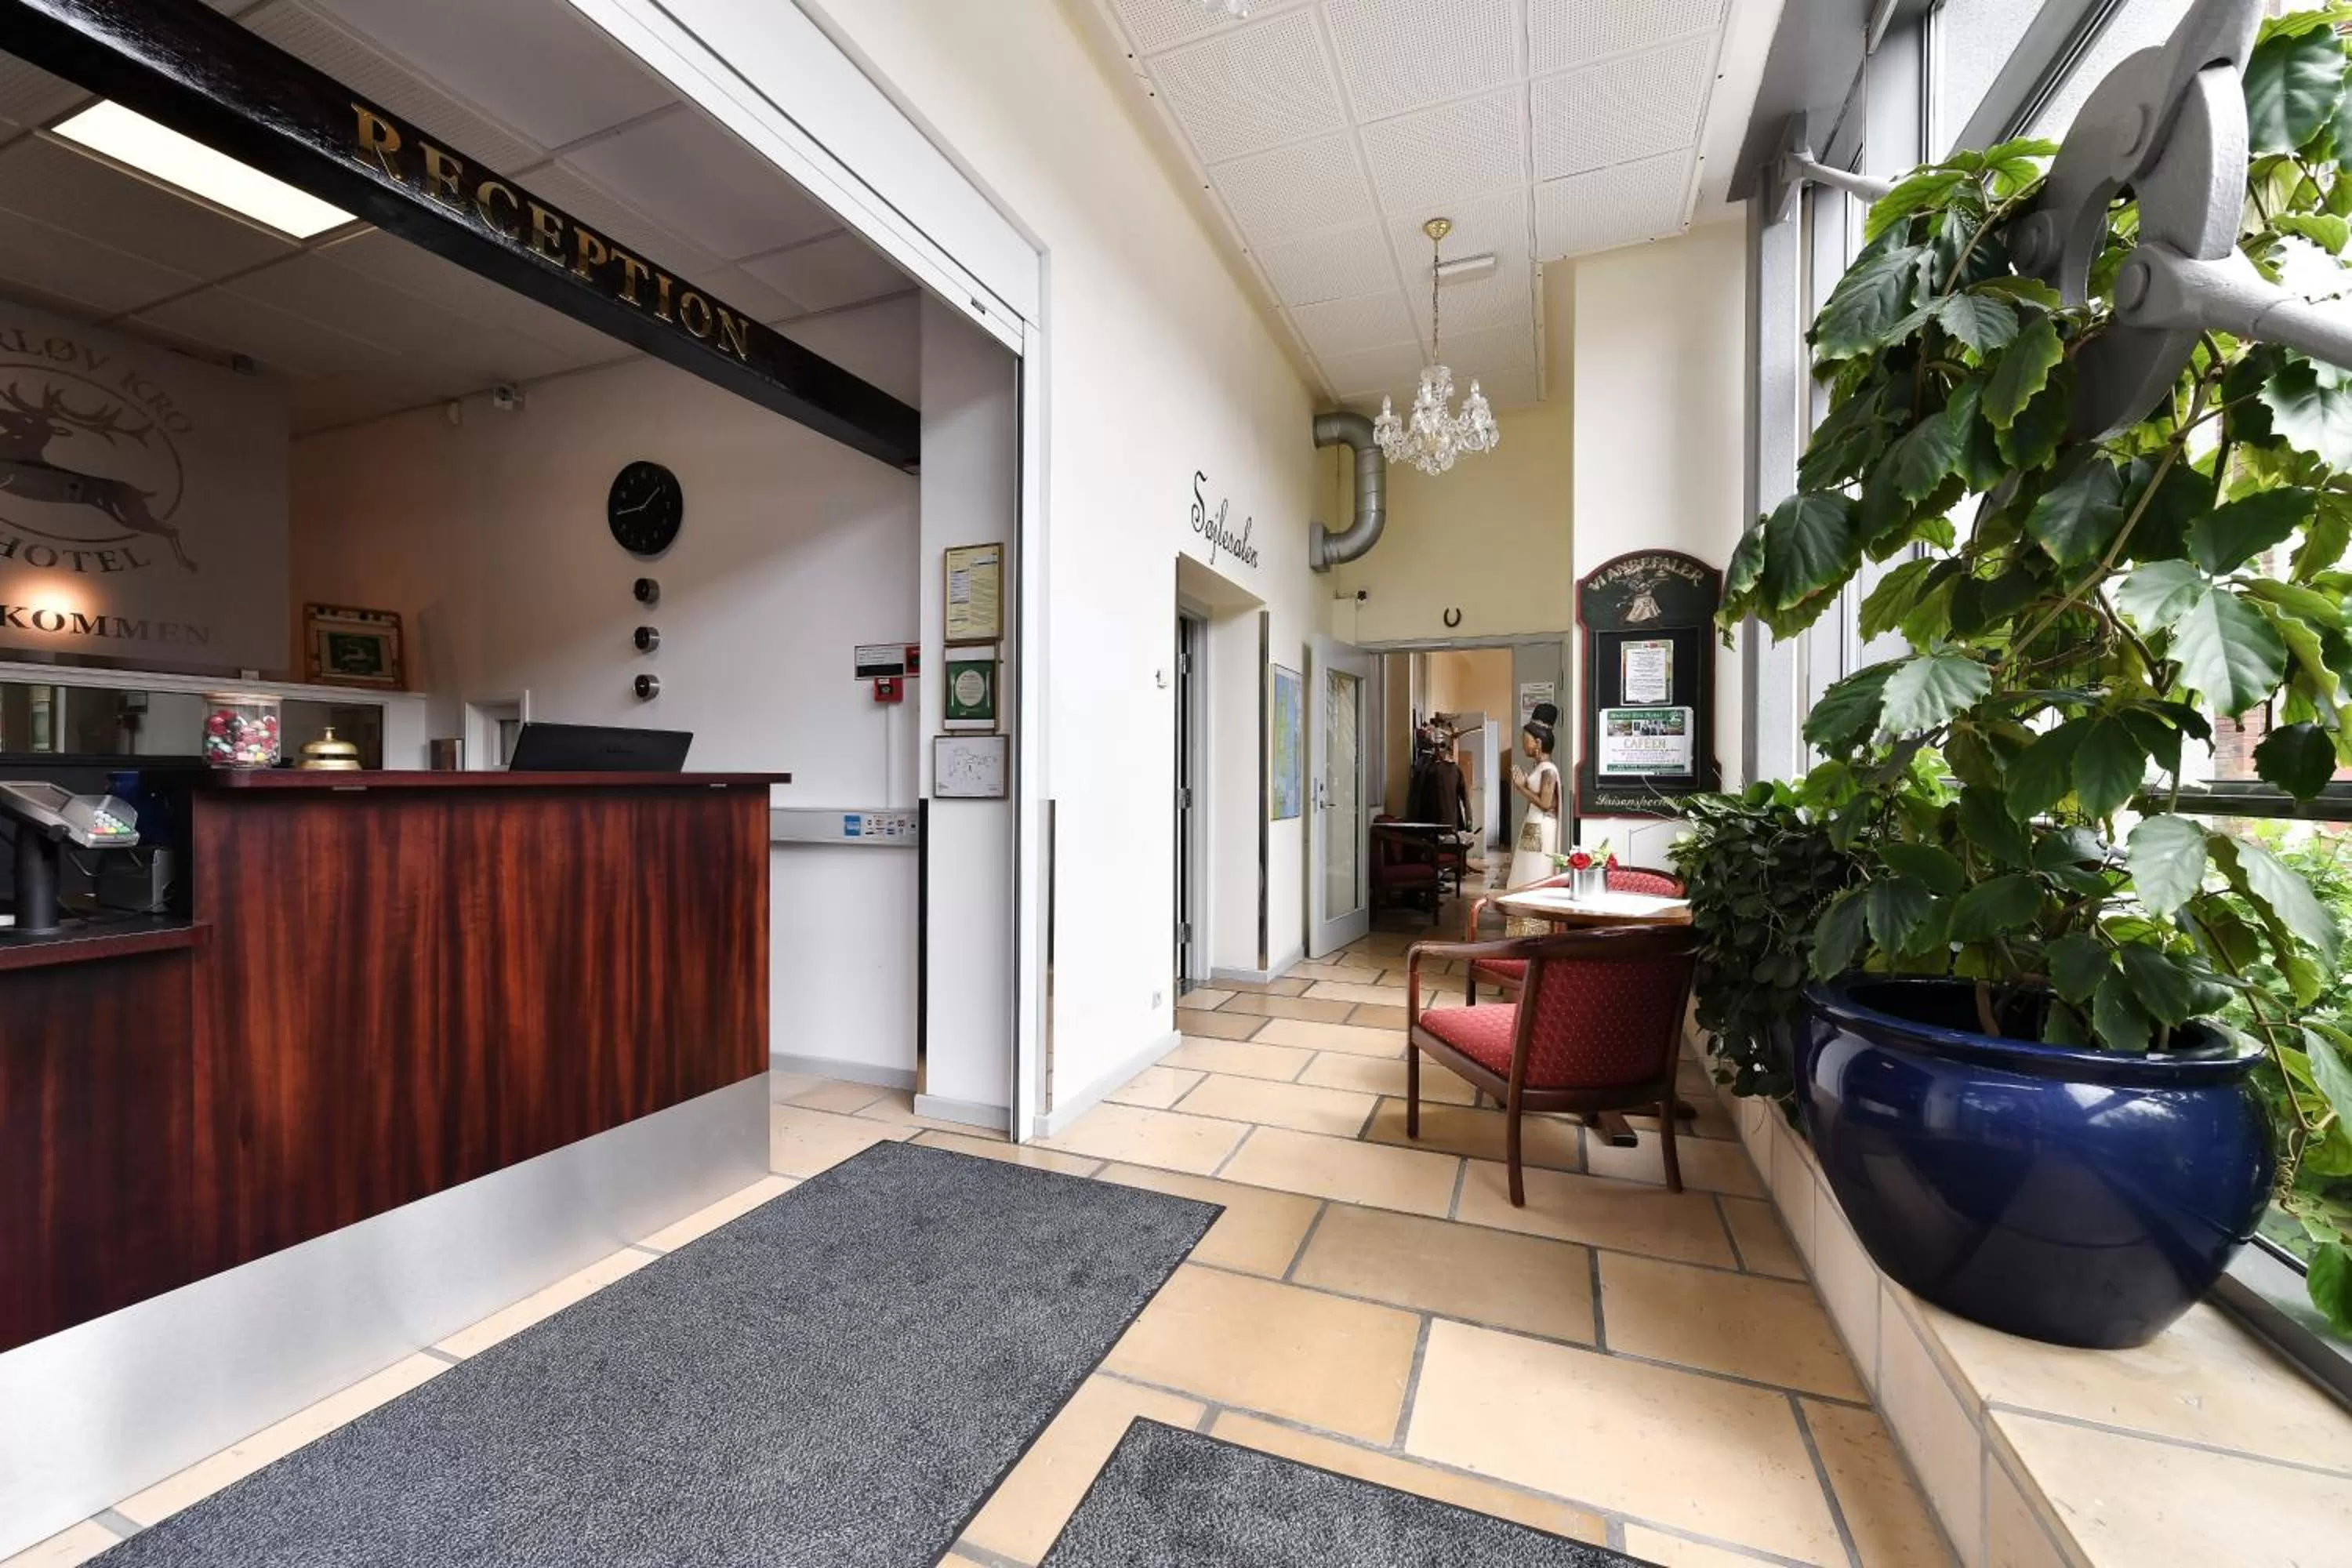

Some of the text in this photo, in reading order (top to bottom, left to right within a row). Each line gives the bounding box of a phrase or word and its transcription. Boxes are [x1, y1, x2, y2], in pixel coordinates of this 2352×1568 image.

[351, 102, 750, 361] RECEPTION
[120, 370, 192, 434] KRO
[1588, 556, 1704, 590] VI ANBEFALER
